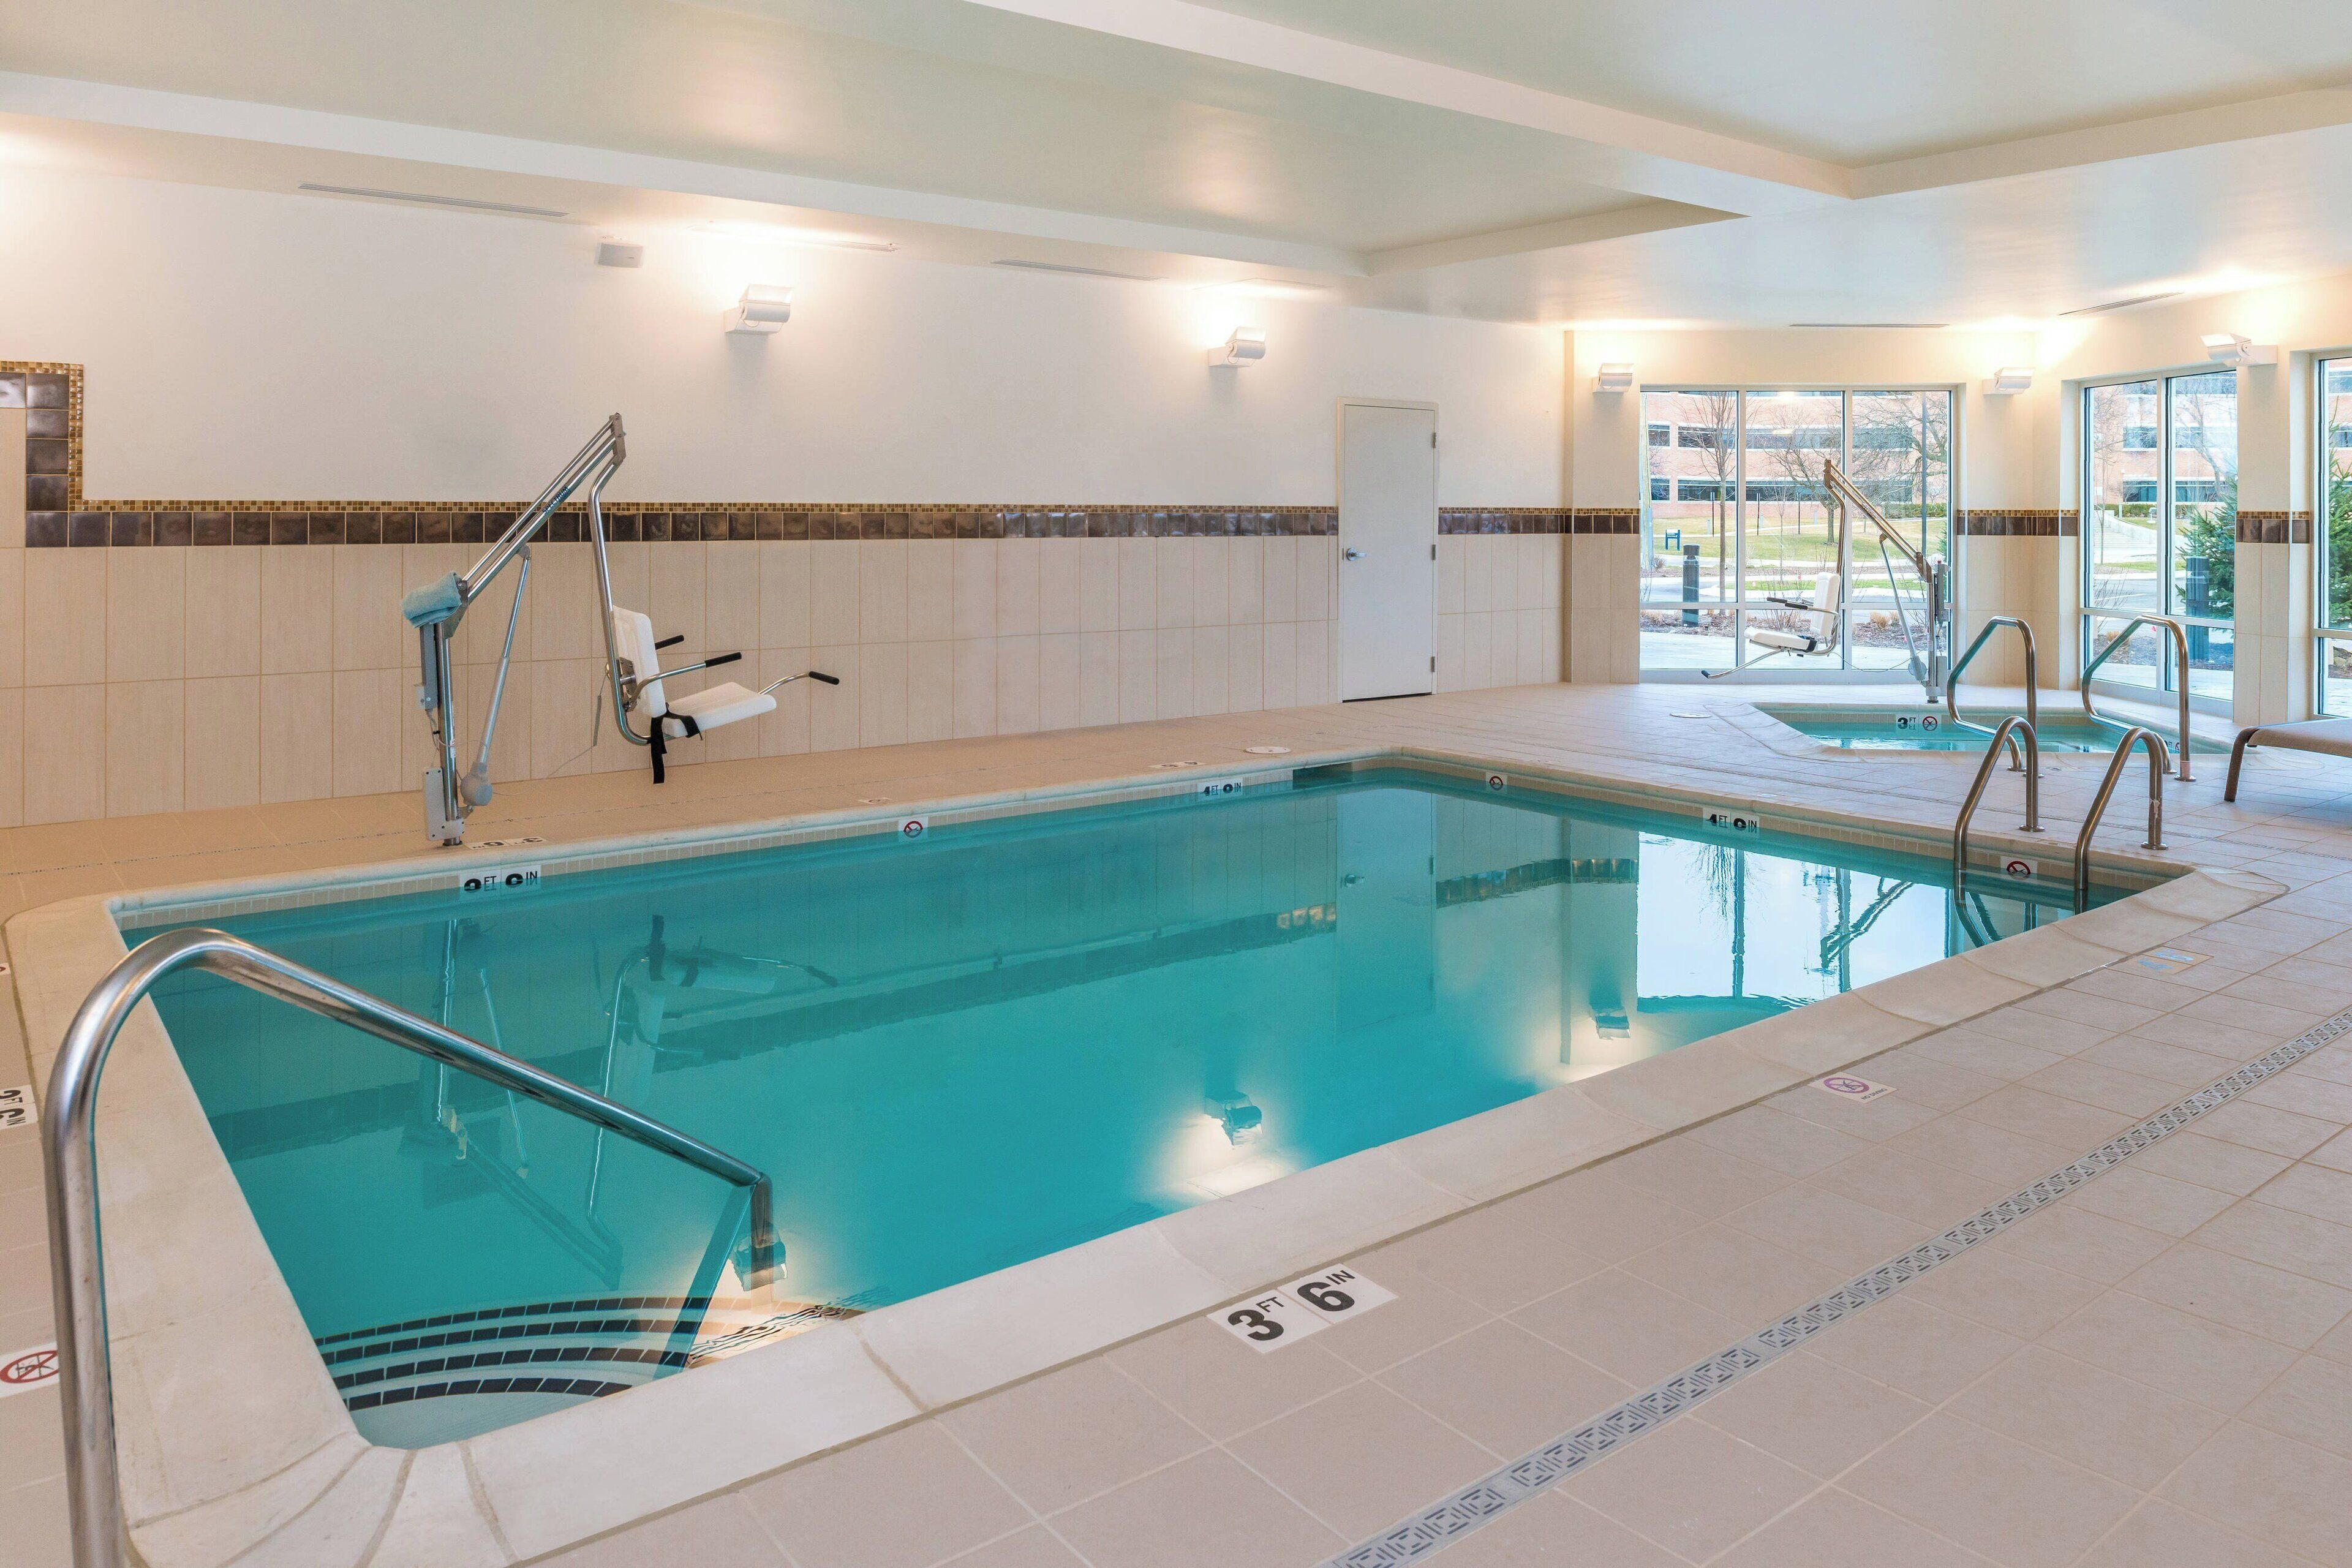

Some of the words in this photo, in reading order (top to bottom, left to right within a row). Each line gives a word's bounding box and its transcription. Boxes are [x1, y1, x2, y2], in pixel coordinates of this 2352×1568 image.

[484, 875, 497, 885] FT
[526, 870, 538, 880] IN
[7, 1117, 26, 1126] IN
[1325, 1270, 1355, 1285] IN
[1297, 1282, 1355, 1311] 6
[1256, 1297, 1284, 1313] FT
[1227, 1310, 1284, 1341] 3
